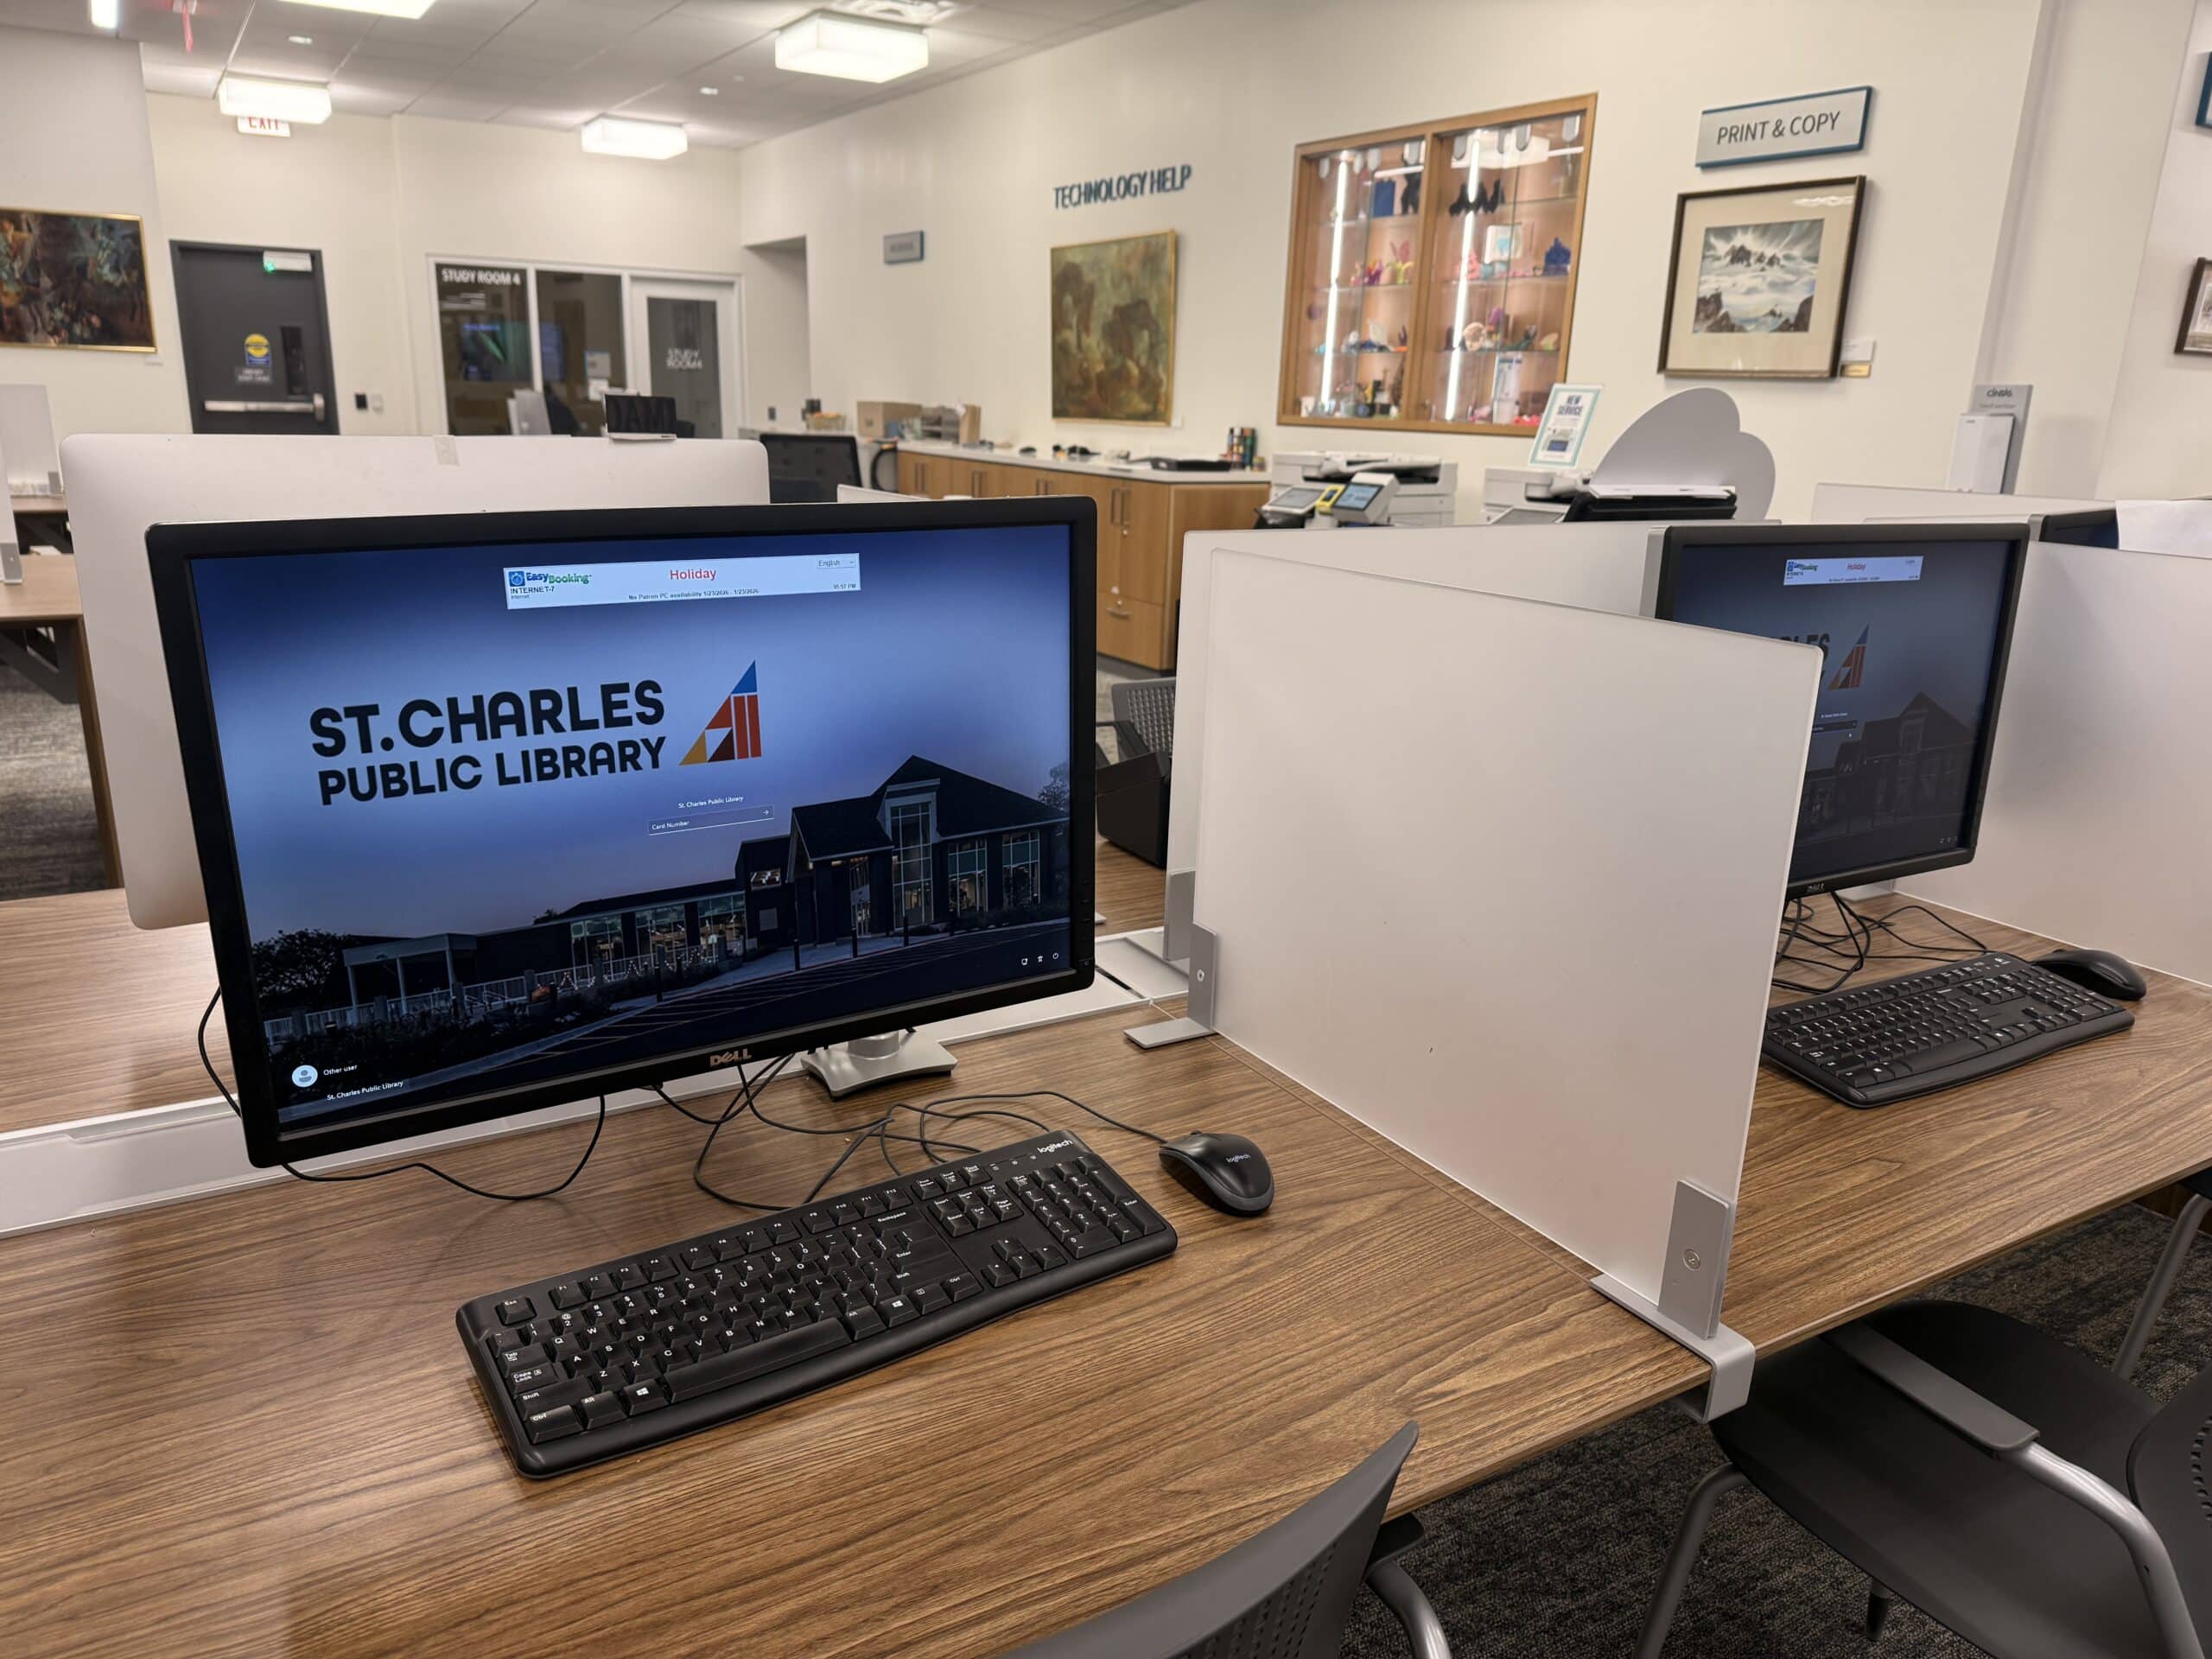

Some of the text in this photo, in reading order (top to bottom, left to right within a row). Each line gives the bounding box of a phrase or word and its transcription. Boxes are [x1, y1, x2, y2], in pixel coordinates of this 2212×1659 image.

[1717, 111, 1841, 145] PRINT & COPY
[1053, 164, 1192, 210] TECHNOLOGY HELP
[442, 268, 521, 286] STUDY ROOM 4
[668, 347, 699, 359] STUDY
[670, 569, 716, 581] Holiday
[318, 736, 667, 805] PUBLIC LIBRARY
[686, 799, 707, 808] Charles
[725, 795, 744, 804] Library
[709, 1048, 752, 1067] DELL
[323, 1067, 342, 1076] Other
[336, 1089, 361, 1099] Charles
[361, 1085, 381, 1095] Public
[382, 1081, 404, 1091] Library
[1037, 1139, 1073, 1154] logitech
[1226, 1154, 1251, 1163] logitech
[877, 1211, 906, 1222] Backspace
[522, 1392, 540, 1401] Shift
[530, 1413, 547, 1421] Ctrl
